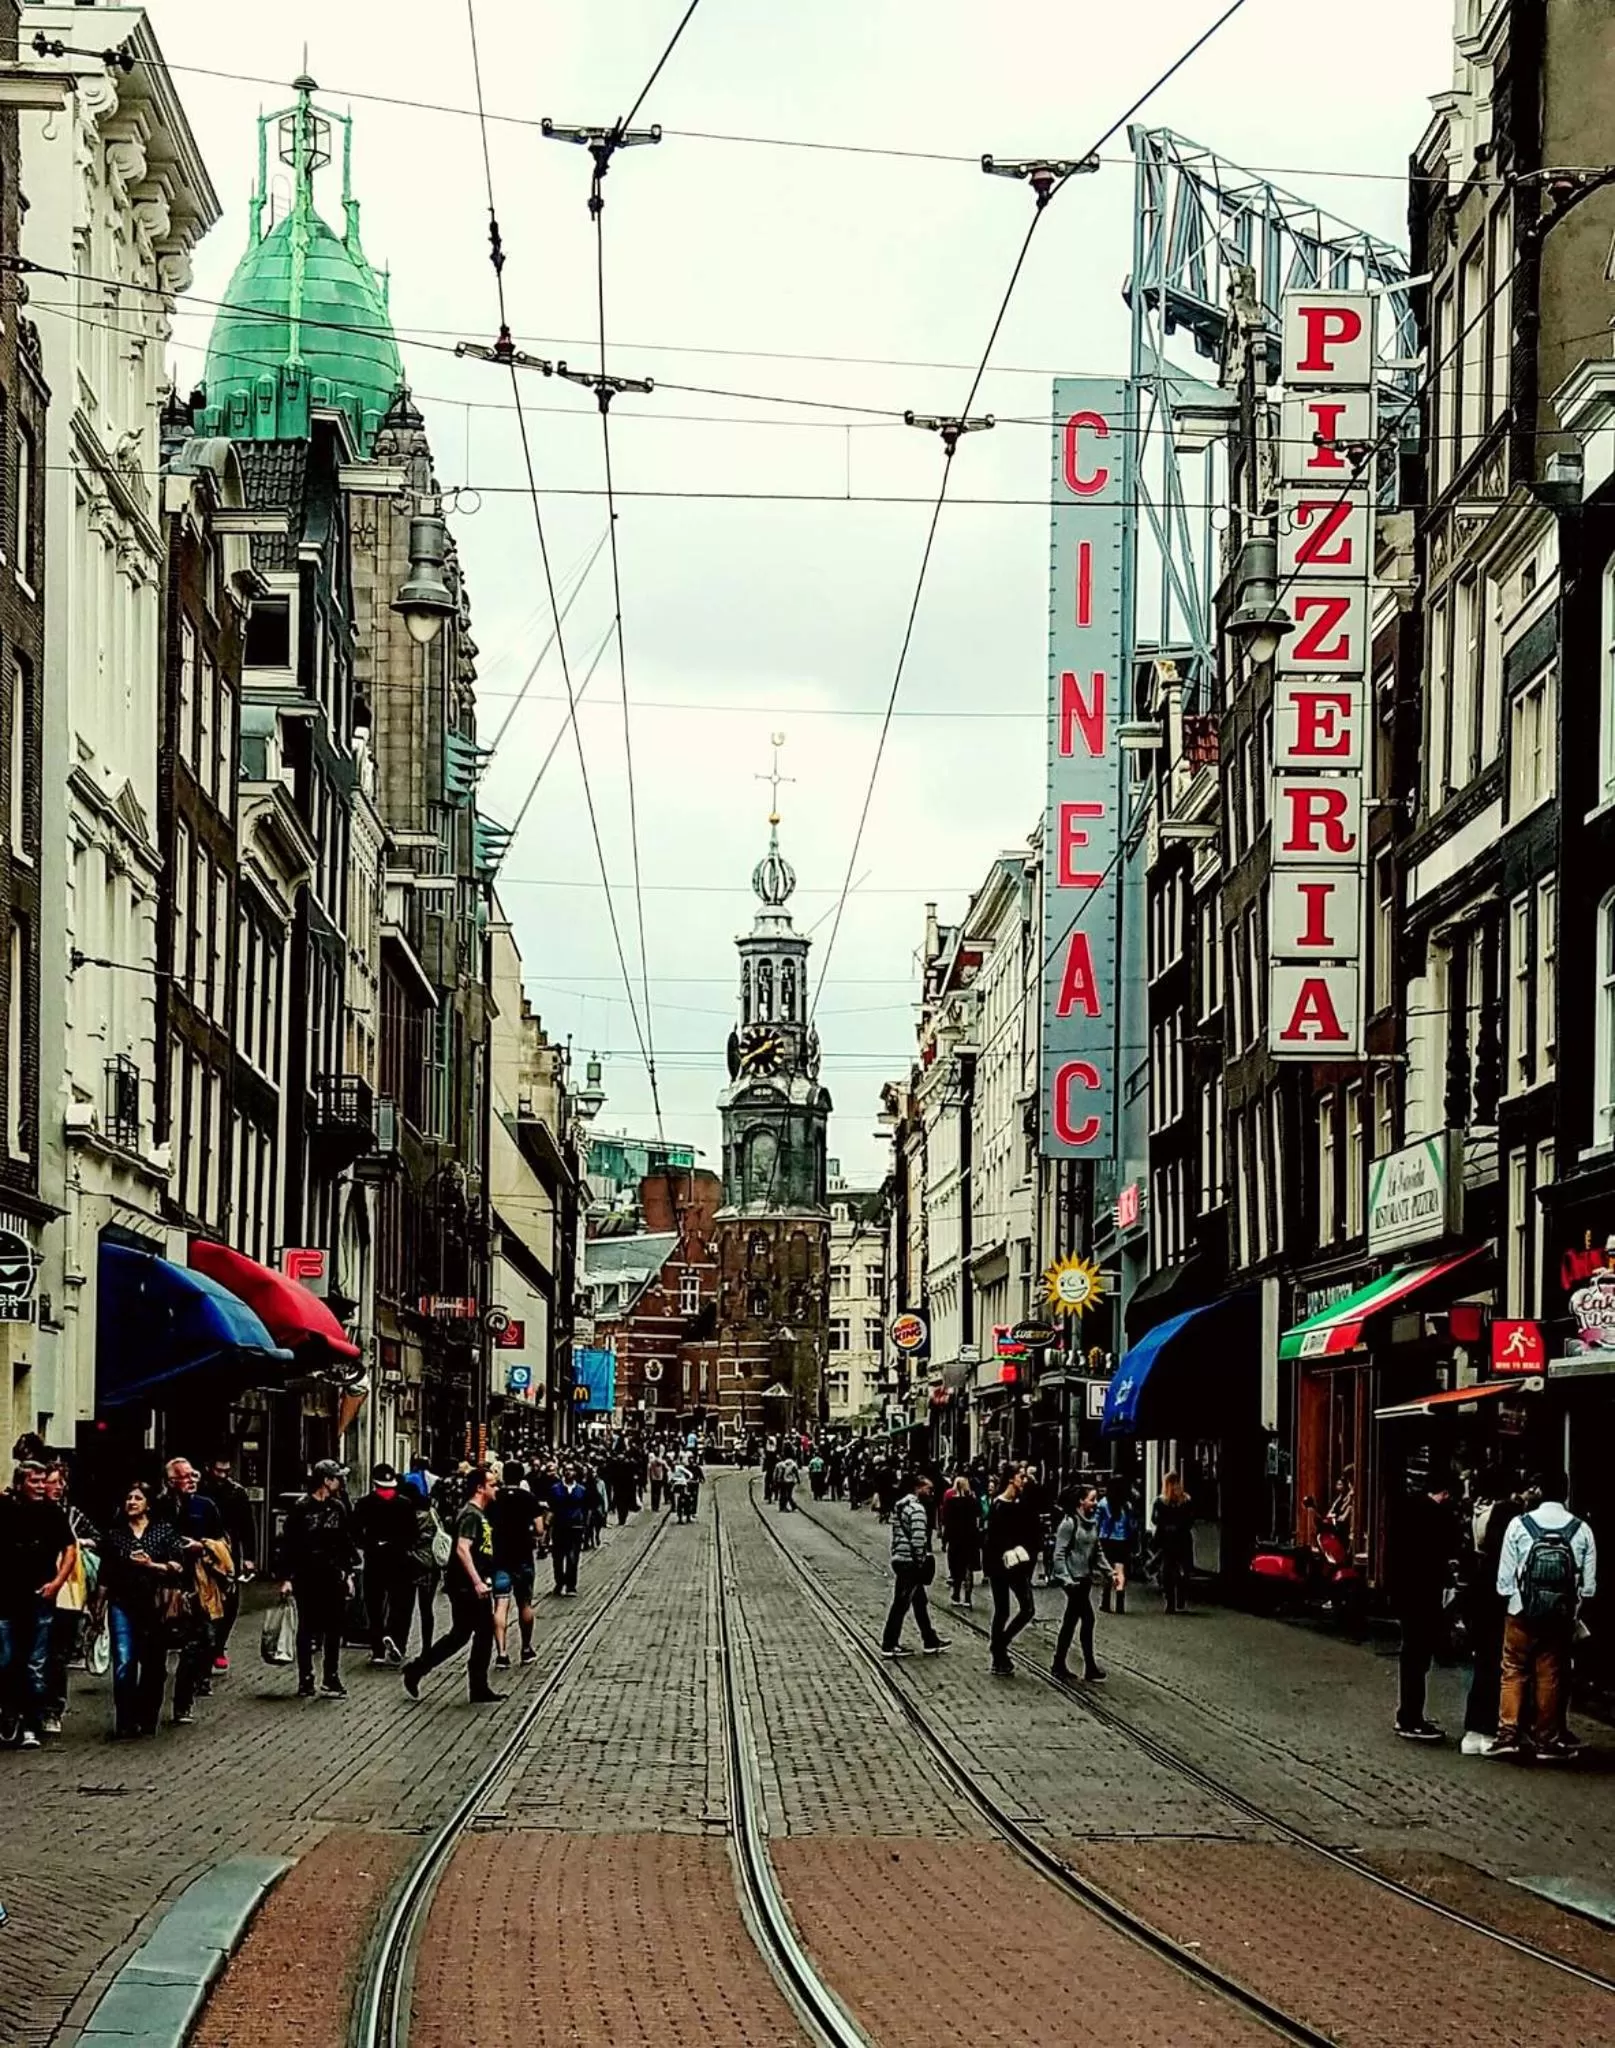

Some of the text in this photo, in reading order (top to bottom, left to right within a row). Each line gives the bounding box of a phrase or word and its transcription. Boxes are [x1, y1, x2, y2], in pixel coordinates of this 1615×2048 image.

[1051, 409, 1110, 1147] CINEAC
[1280, 306, 1362, 1041] PIZZERIA
[895, 1328, 922, 1341] KING
[1013, 1329, 1055, 1339] SUBWAY
